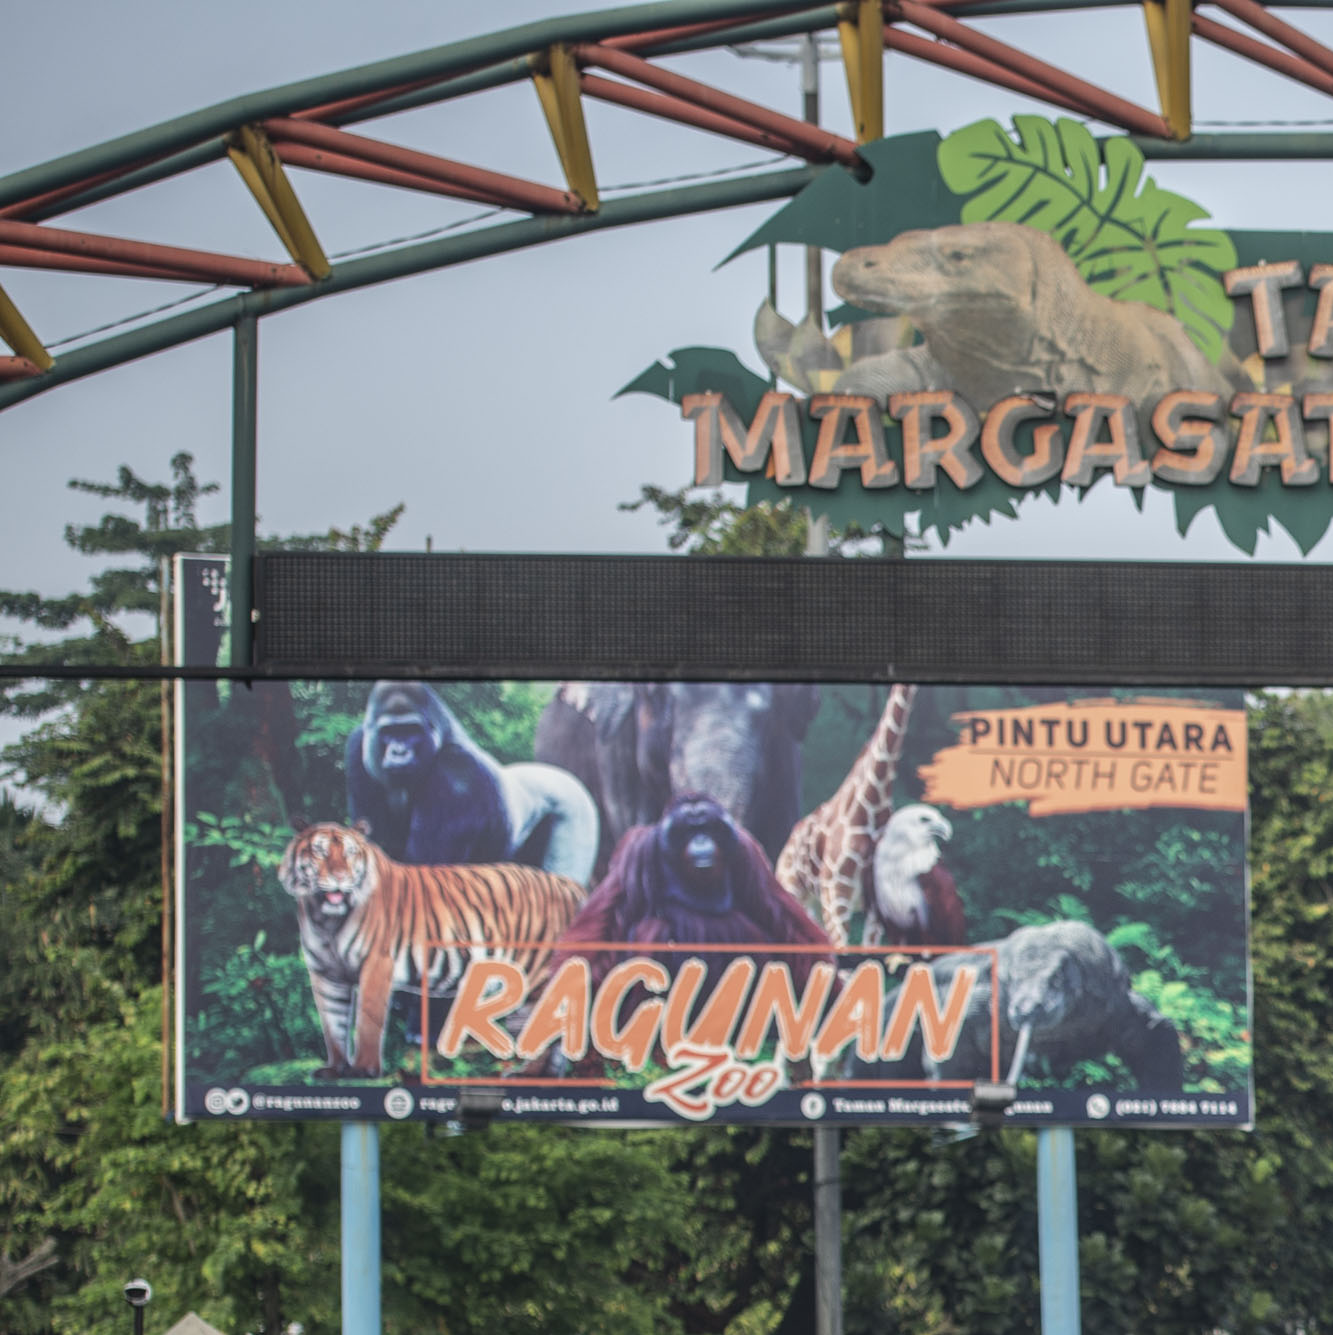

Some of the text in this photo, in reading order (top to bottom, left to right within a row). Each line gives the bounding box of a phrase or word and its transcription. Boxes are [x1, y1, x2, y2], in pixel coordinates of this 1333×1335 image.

[969, 717, 1234, 753] PINTU UTARA
[989, 757, 1221, 795] NORTH GATE
[438, 957, 978, 1072] RAGUNAN
[645, 1045, 787, 1120] Zoo
